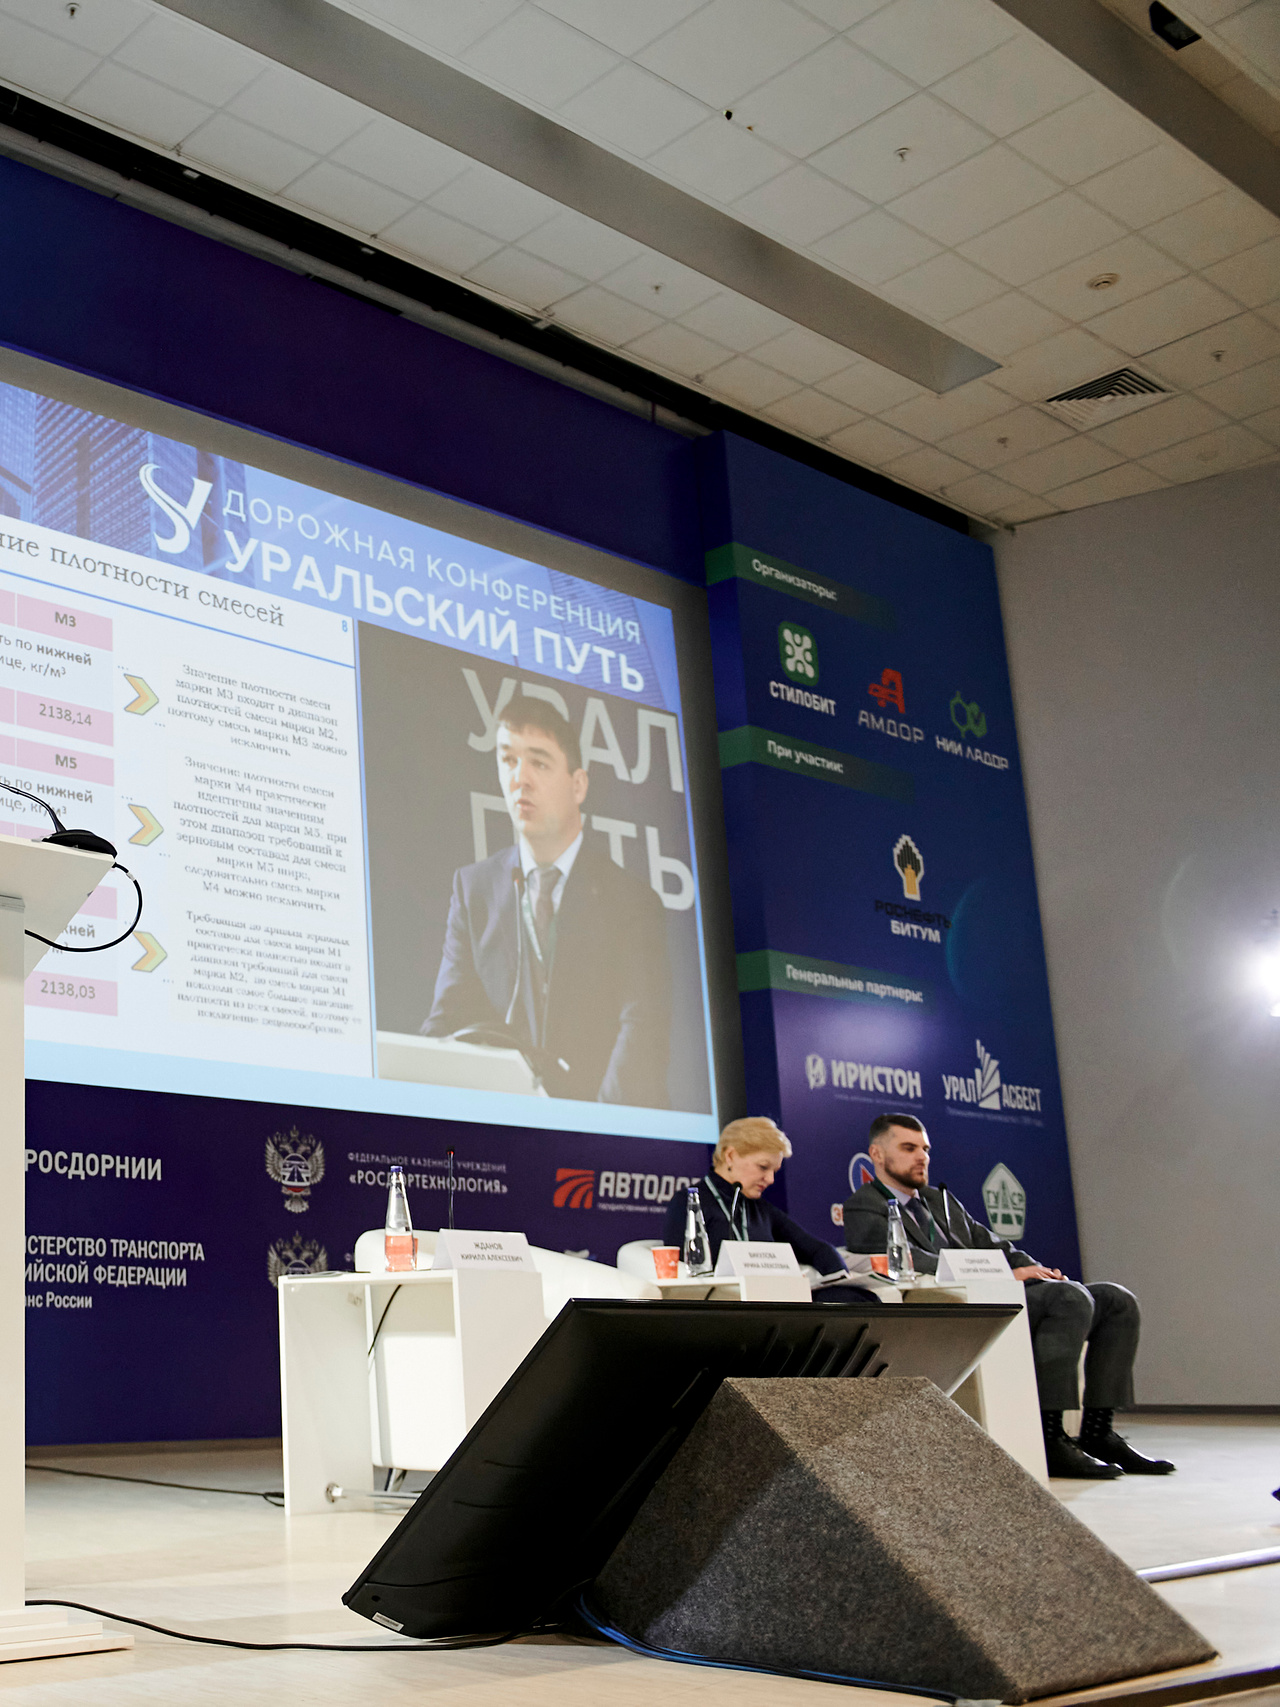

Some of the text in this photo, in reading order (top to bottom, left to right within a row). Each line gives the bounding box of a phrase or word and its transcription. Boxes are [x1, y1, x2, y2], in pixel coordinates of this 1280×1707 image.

[222, 489, 640, 645] ДОРОЖНАЯ КОНФЕРЕНЦИЯ
[50, 544, 189, 601] плотности
[198, 586, 286, 627] смесей
[54, 611, 77, 628] М3
[224, 529, 644, 693] УРАЛЬСКИЙ ПУТЬ
[16, 638, 32, 651] по
[36, 642, 92, 666] нижней
[183, 664, 237, 686] Значение
[241, 681, 297, 702] плотности
[769, 680, 837, 716] СТИЛОБИТ
[39, 703, 92, 726] 2138,14
[857, 709, 925, 744] АМДОР
[767, 740, 792, 760] При
[935, 735, 963, 757] НИИ
[55, 754, 77, 769] М5
[15, 779, 32, 791] по
[37, 783, 93, 804] нижней
[874, 900, 952, 929] РОСНЕФТЬ
[890, 920, 941, 944] БИТУМ
[41, 980, 96, 999] 2138,03
[785, 963, 864, 992] Генеральные
[831, 1059, 922, 1099] ИРИСТОН
[942, 1074, 977, 1103] УРАЛ
[1002, 1084, 1042, 1112] АСБЕСТ
[25, 1149, 162, 1182] РОСДОРНИИ
[348, 1152, 408, 1166] ФЕДЕРАЛЬНОЕ
[457, 1161, 507, 1173] УЧРЕЖДЕНИЕ
[110, 1238, 205, 1261] ТРАНСПОРТА
[460, 1253, 486, 1261] КИРИЛЛ
[473, 1242, 503, 1251] ЖДАНОВ
[93, 1263, 187, 1289] ФЕДЕРАЦИИ
[46, 1291, 93, 1308] России
